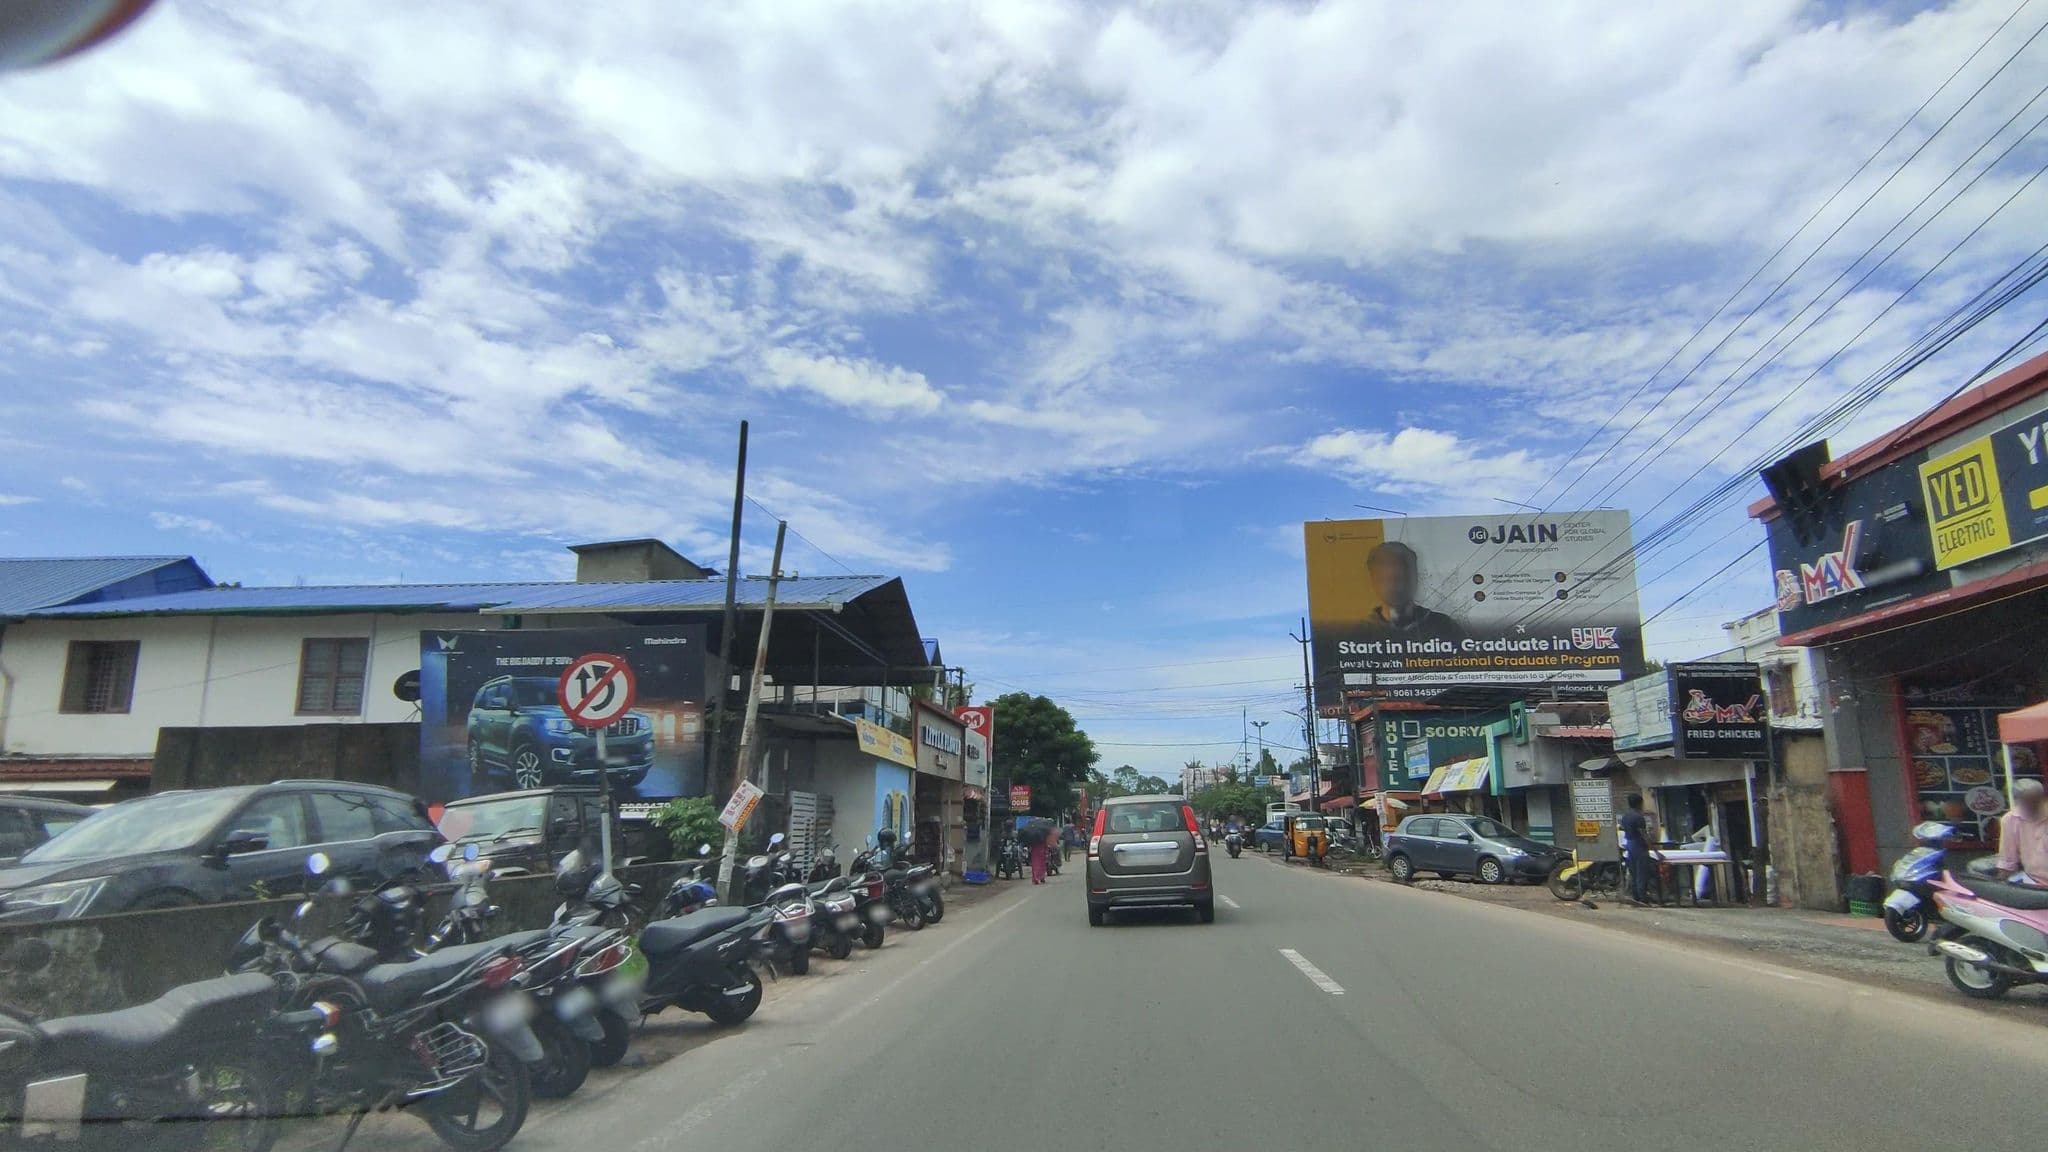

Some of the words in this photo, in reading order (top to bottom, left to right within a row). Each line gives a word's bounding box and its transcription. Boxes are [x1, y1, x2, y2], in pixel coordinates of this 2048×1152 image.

[1930, 461, 1986, 517] YED
[1490, 523, 1558, 544] JAIN
[1937, 517, 1996, 554] ELECTRIC
[1800, 520, 1866, 605] MAX
[1338, 640, 1383, 654] Start
[1385, 639, 1403, 654] in
[1406, 638, 1458, 655] India,
[1461, 637, 1549, 652] Graduate
[1552, 635, 1570, 650] in
[1571, 627, 1620, 650] UK
[496, 657, 509, 666] THE
[545, 656, 554, 665] OF
[1339, 660, 1364, 669] Level
[1382, 659, 1403, 669] with
[1405, 655, 1490, 668] International
[1494, 654, 1557, 666] Graduate
[1561, 654, 1620, 668] Program
[1484, 672, 1529, 681] Progression
[1393, 688, 1413, 697] 9061
[1414, 688, 1449, 697] 3455
[1425, 725, 1488, 738] SOORYA
[1687, 729, 1716, 739] FRIED
[1717, 729, 1761, 739] CHICKEN
[1385, 721, 1399, 786] HOTEL
